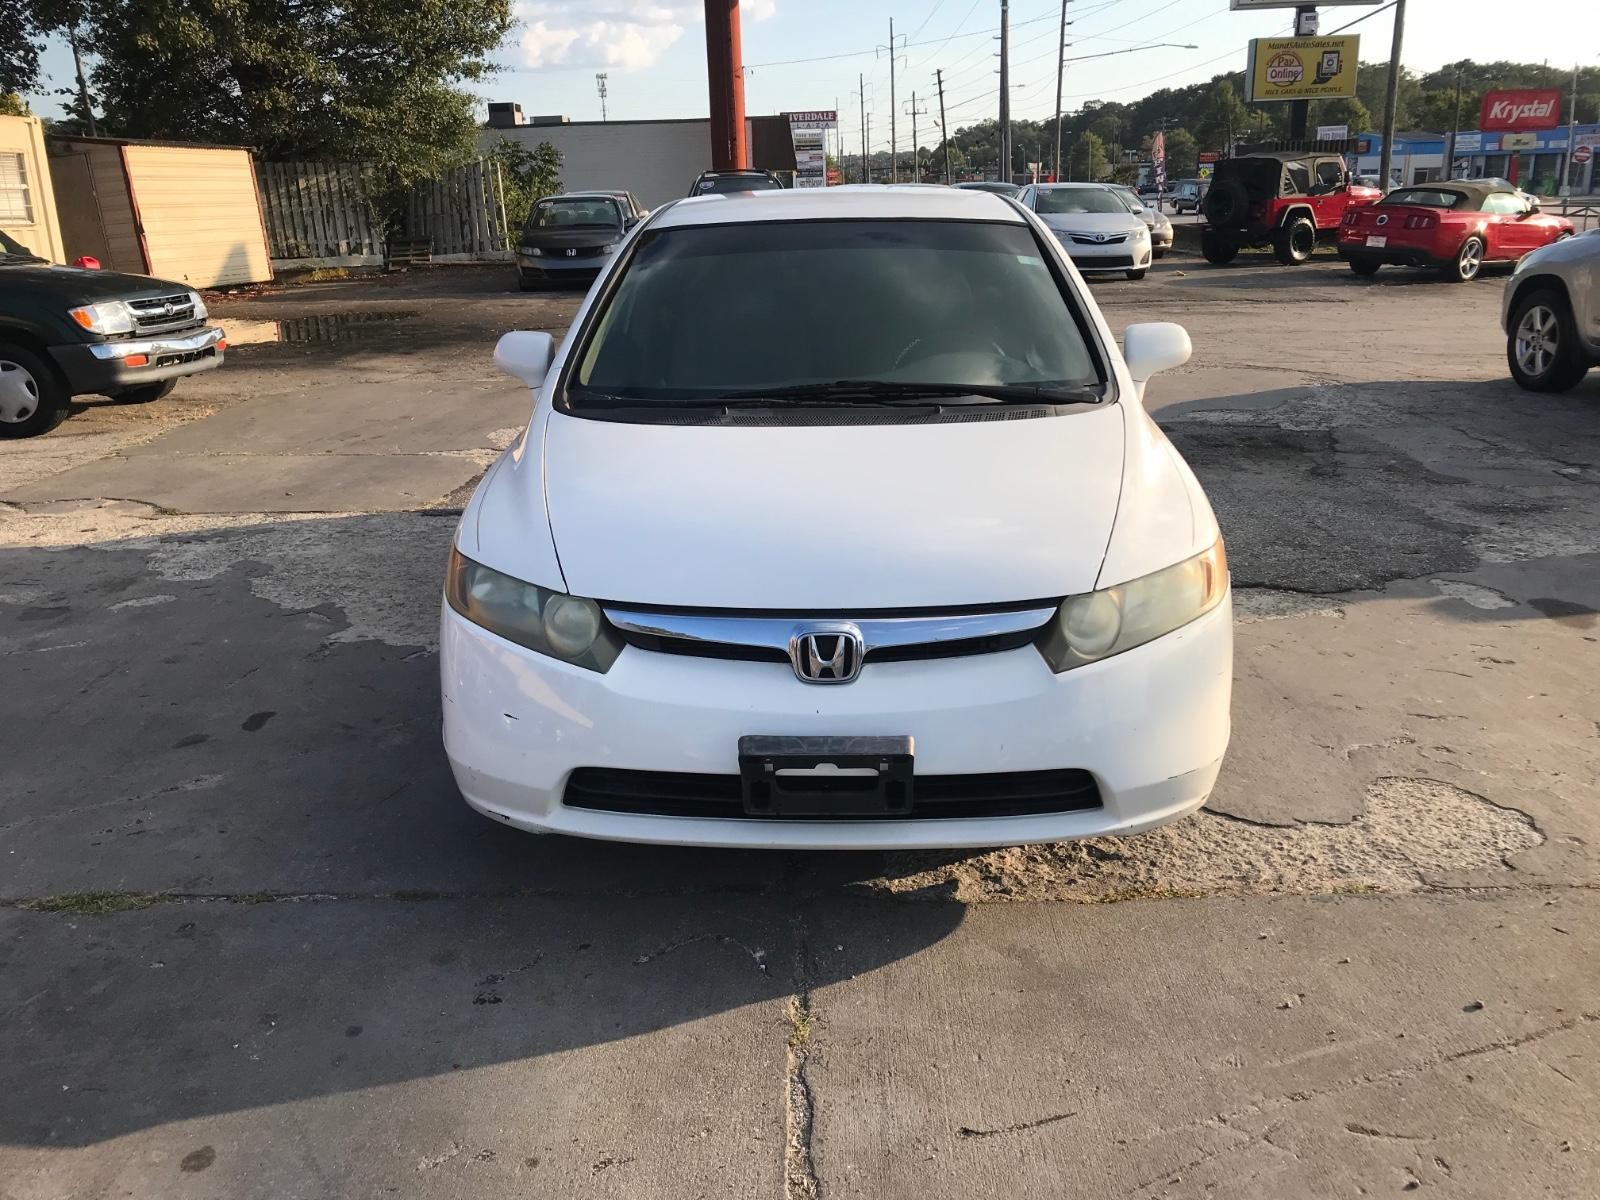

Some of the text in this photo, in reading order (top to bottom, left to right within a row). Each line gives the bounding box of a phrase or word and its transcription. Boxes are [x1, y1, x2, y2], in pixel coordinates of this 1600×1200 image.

[1278, 57, 1294, 67] Pay
[1270, 68, 1299, 79] Online
[1489, 99, 1555, 123] Krystal
[788, 112, 834, 121] IVERDALE
